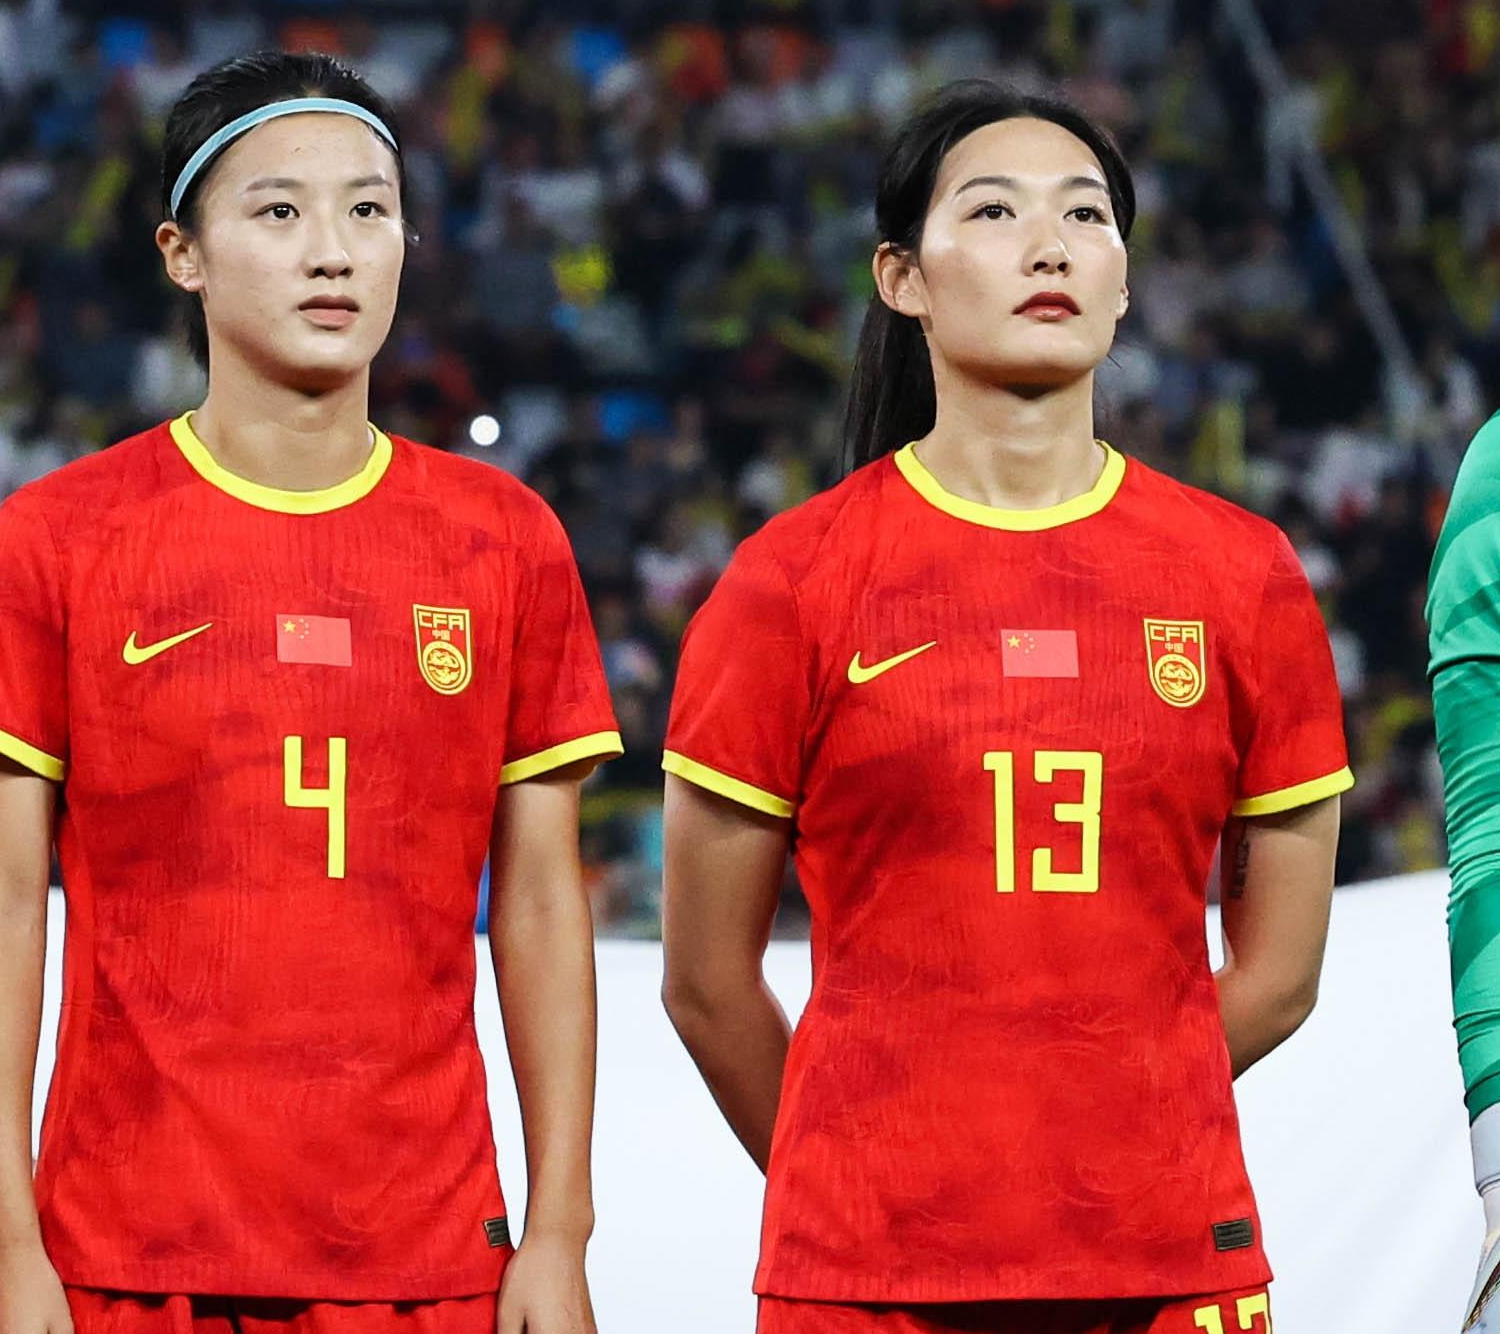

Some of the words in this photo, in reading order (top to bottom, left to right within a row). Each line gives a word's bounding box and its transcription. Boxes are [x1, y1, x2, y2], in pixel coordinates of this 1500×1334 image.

[418, 610, 464, 631] CFA
[1150, 626, 1198, 644] CFA
[284, 735, 347, 879] 4
[982, 750, 1104, 893] 13
